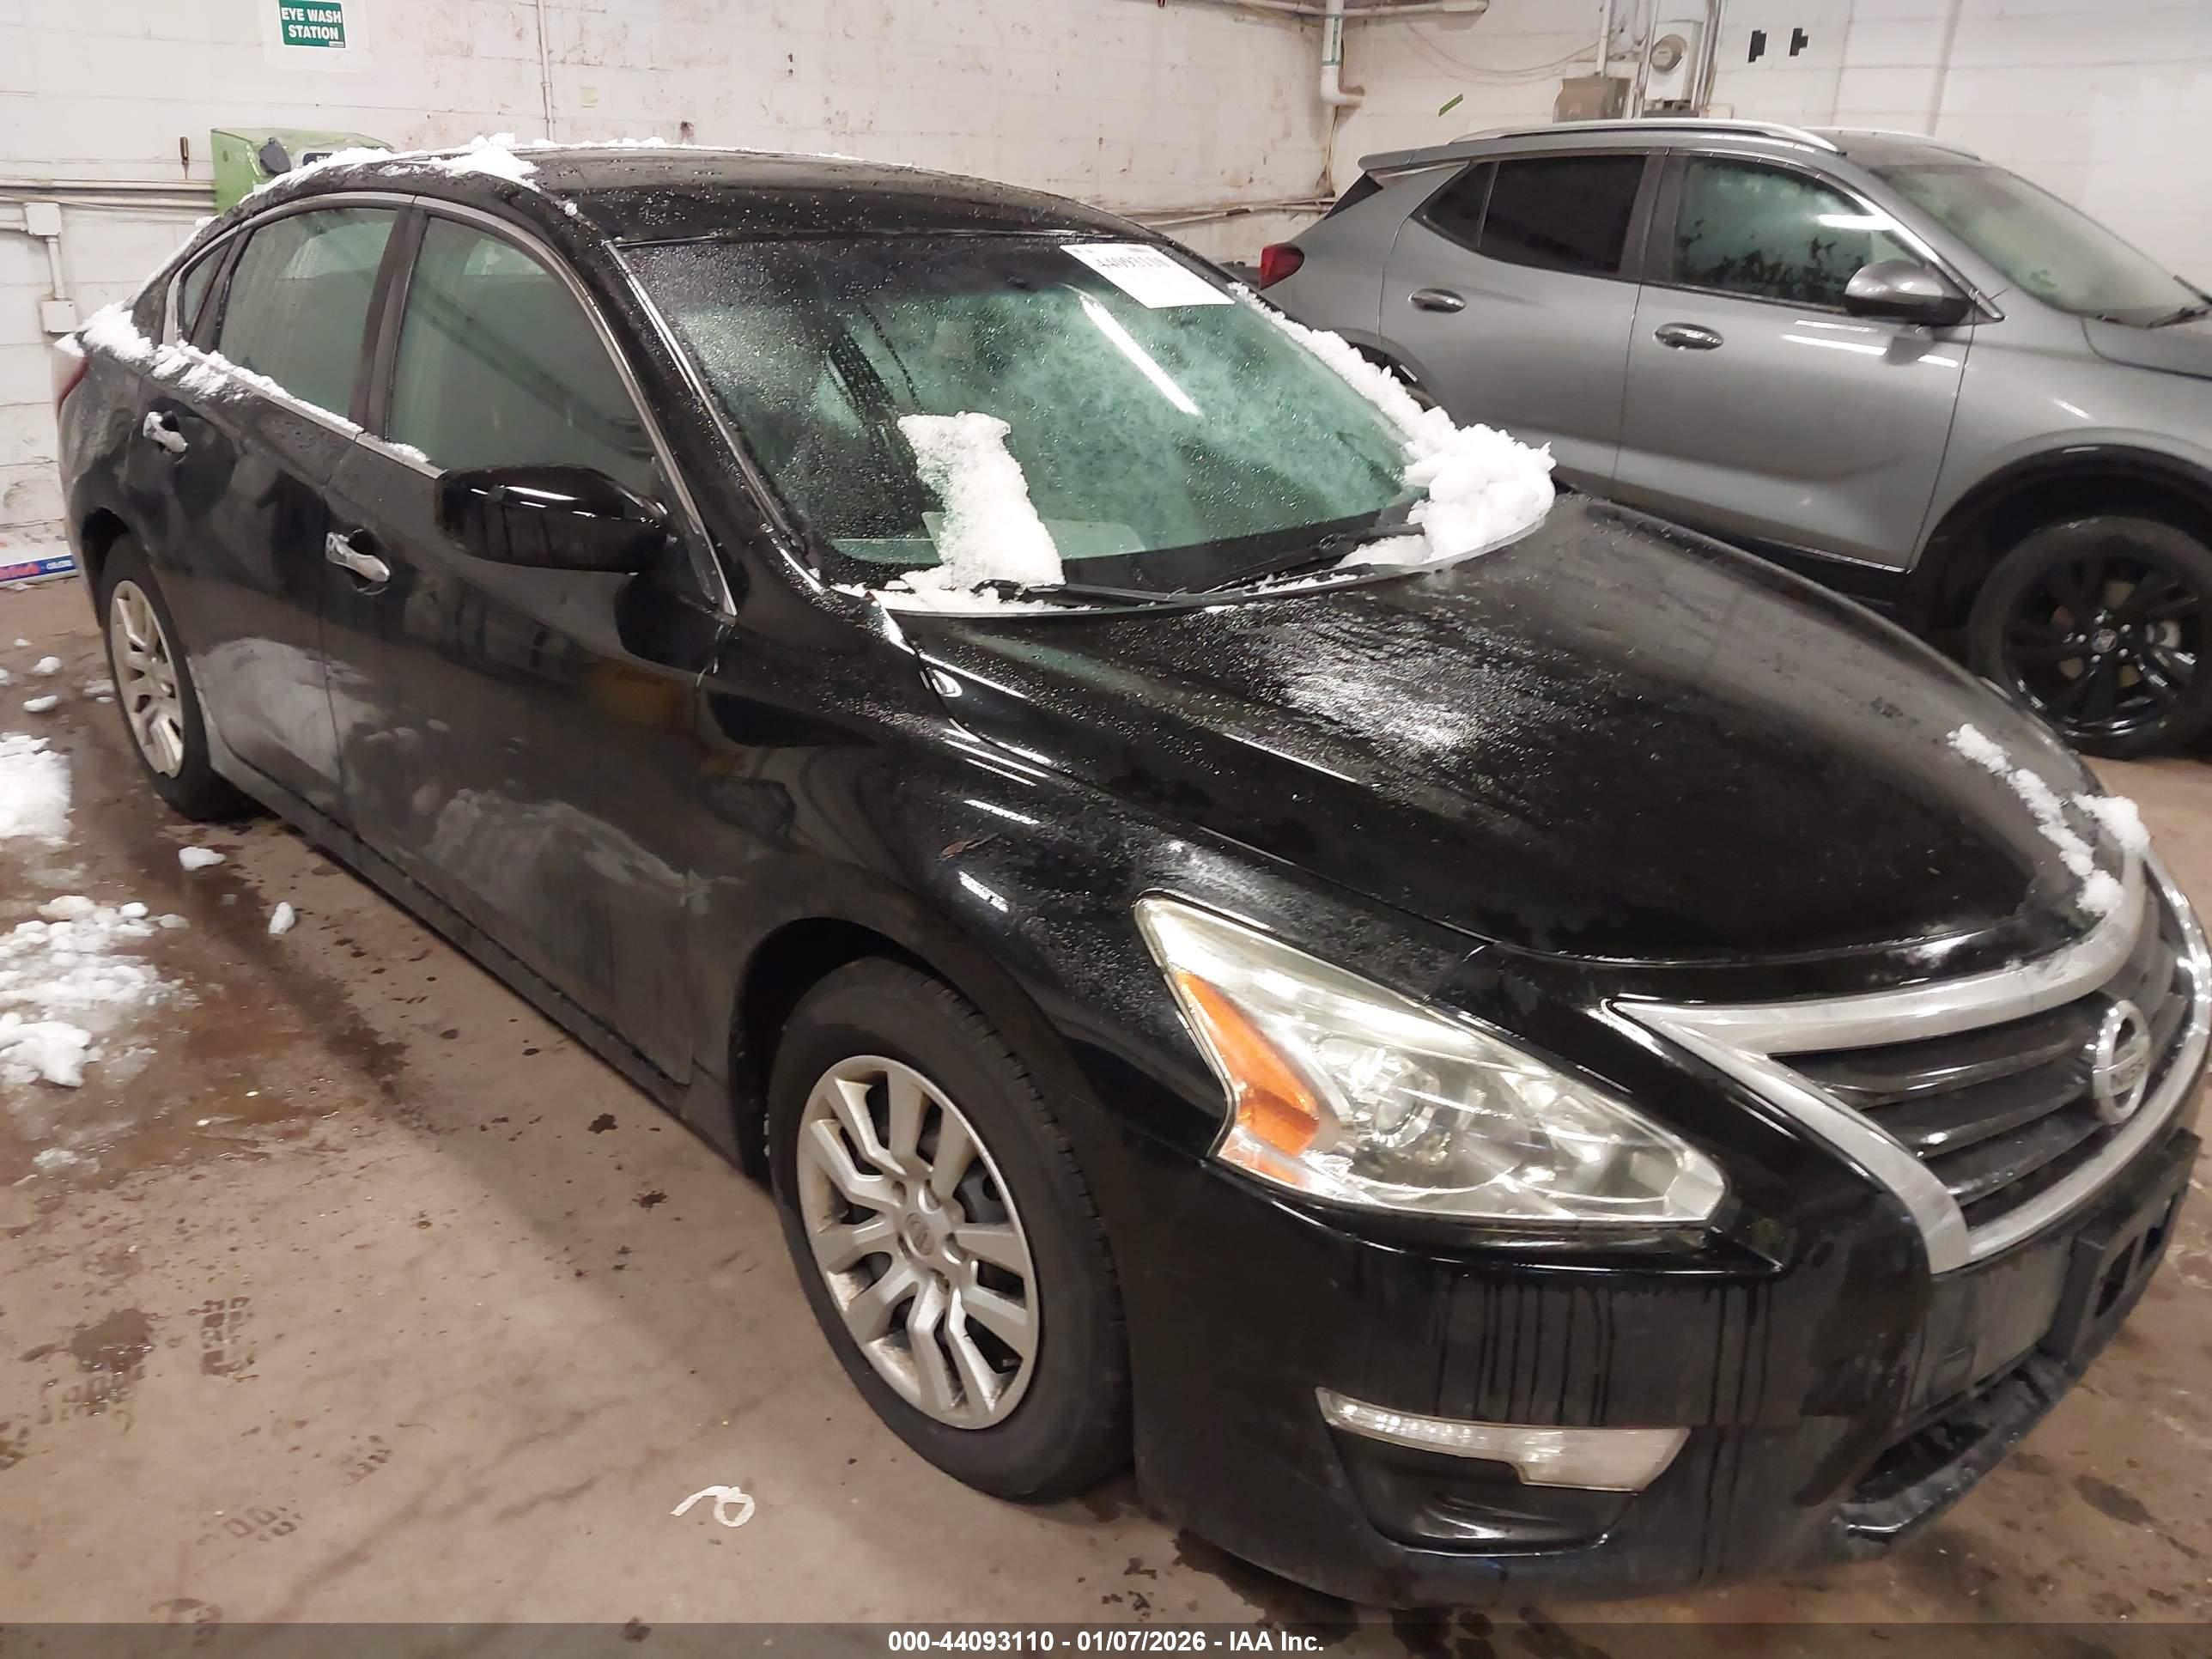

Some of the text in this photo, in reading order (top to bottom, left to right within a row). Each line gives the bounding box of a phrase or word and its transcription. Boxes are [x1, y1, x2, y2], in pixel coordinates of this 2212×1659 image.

[281, 7, 343, 23] EYE WASH
[288, 24, 339, 40] STATION
